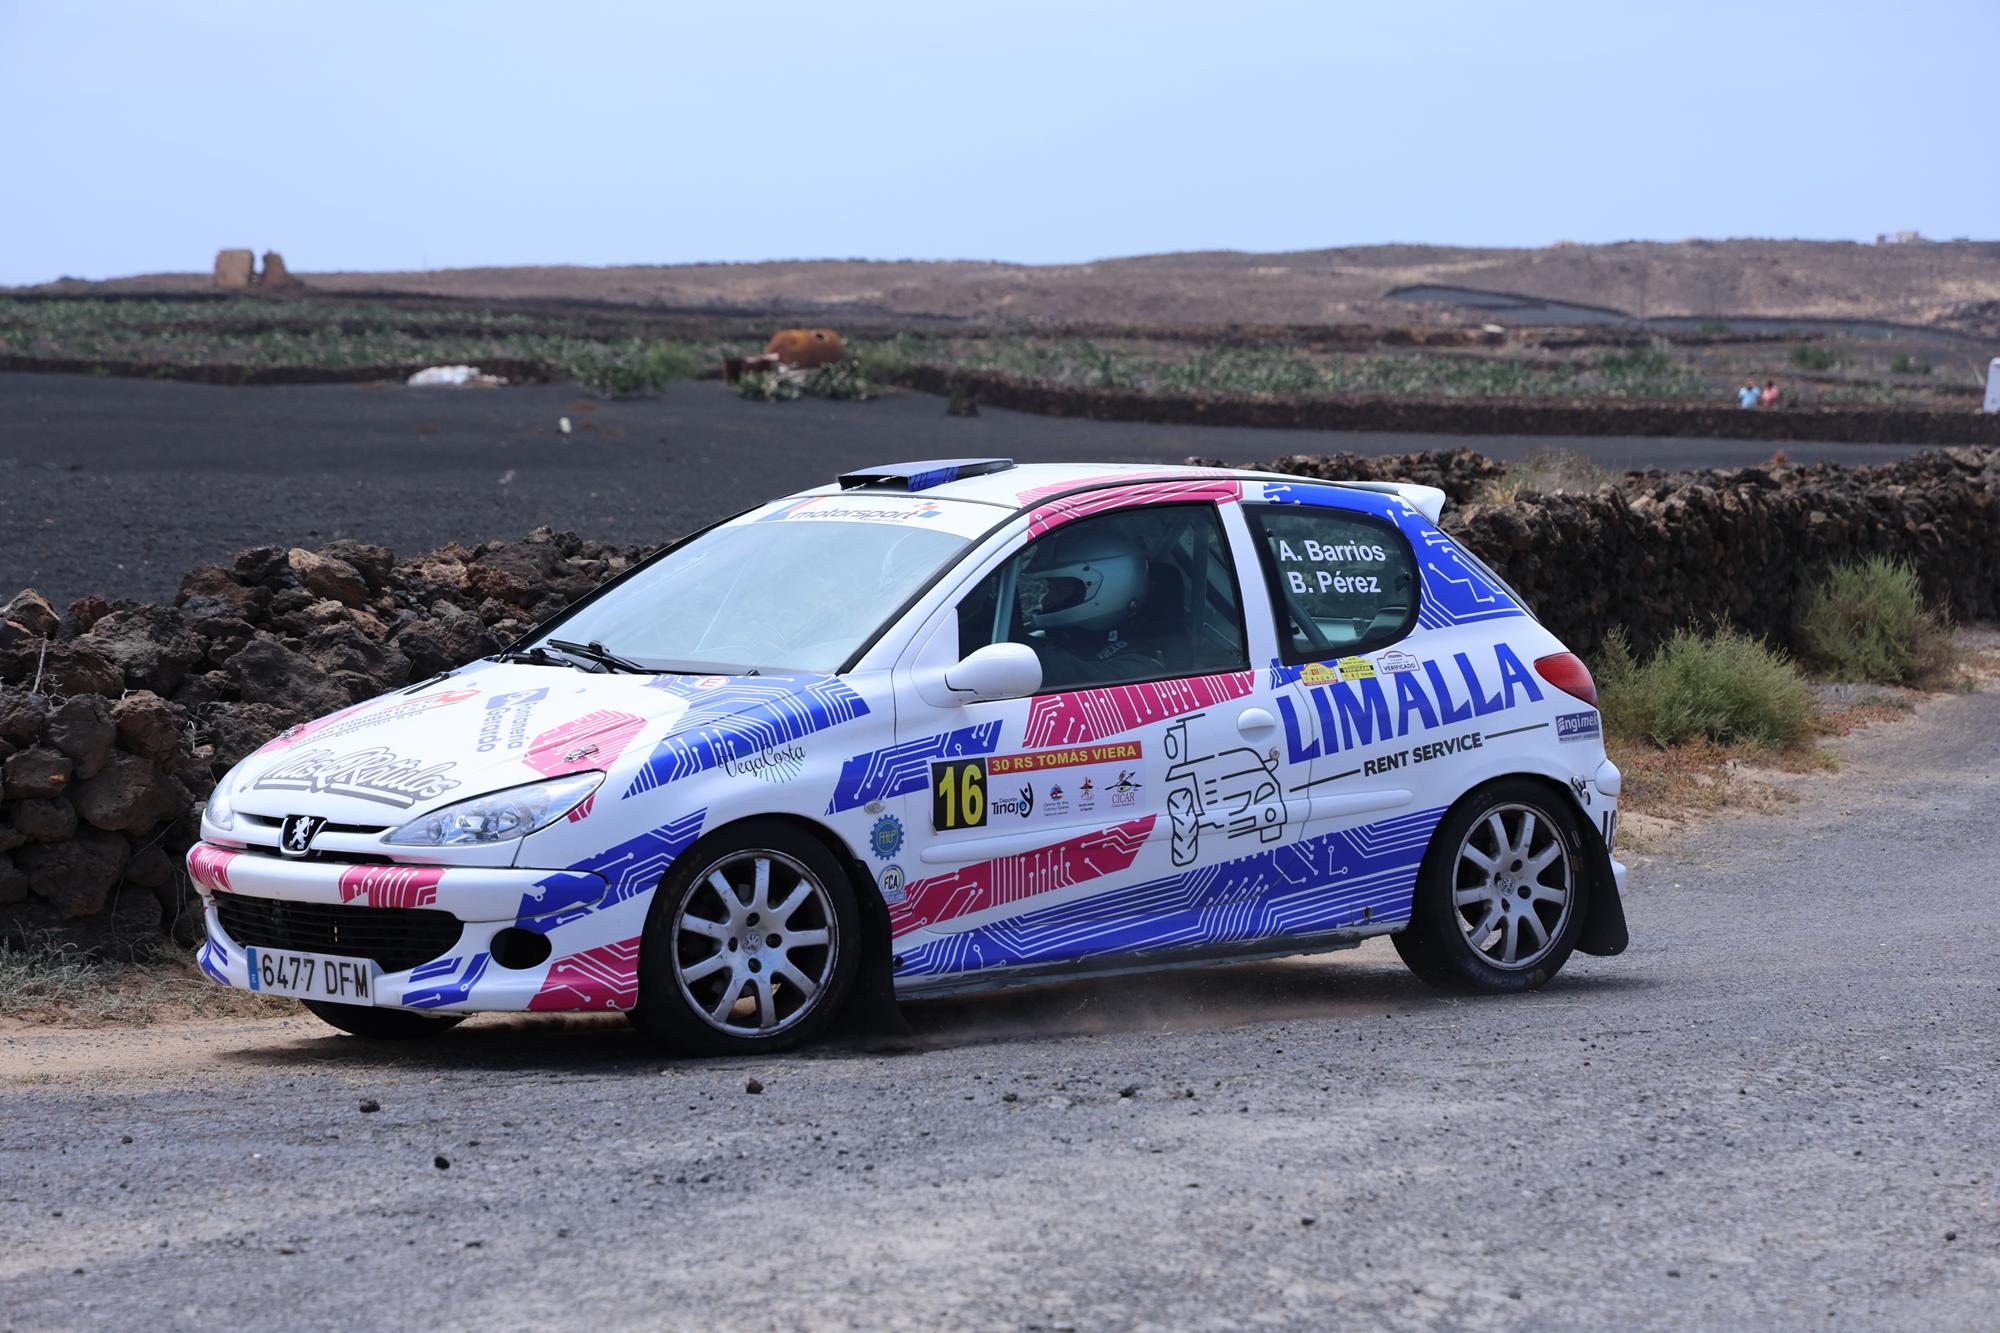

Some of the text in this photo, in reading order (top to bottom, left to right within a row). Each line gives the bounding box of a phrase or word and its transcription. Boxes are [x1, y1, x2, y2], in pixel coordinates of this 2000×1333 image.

[789, 508, 919, 521] motorsport
[1279, 539, 1386, 562] A. Barrios
[1287, 570, 1382, 594] B. Pérez
[1383, 662, 1416, 672] VERIFICADO
[1275, 642, 1545, 765] LIMALLA
[476, 706, 511, 753] Gerardo
[992, 745, 1137, 772] 30 RS TOMÁS VIERA
[1363, 731, 1483, 777] RENT SERVICE
[939, 764, 984, 828] 16
[991, 800, 1028, 816] Tinajo
[1111, 792, 1136, 804] CICAR
[884, 874, 899, 890] FCA
[262, 953, 369, 999] 6477 DFM
